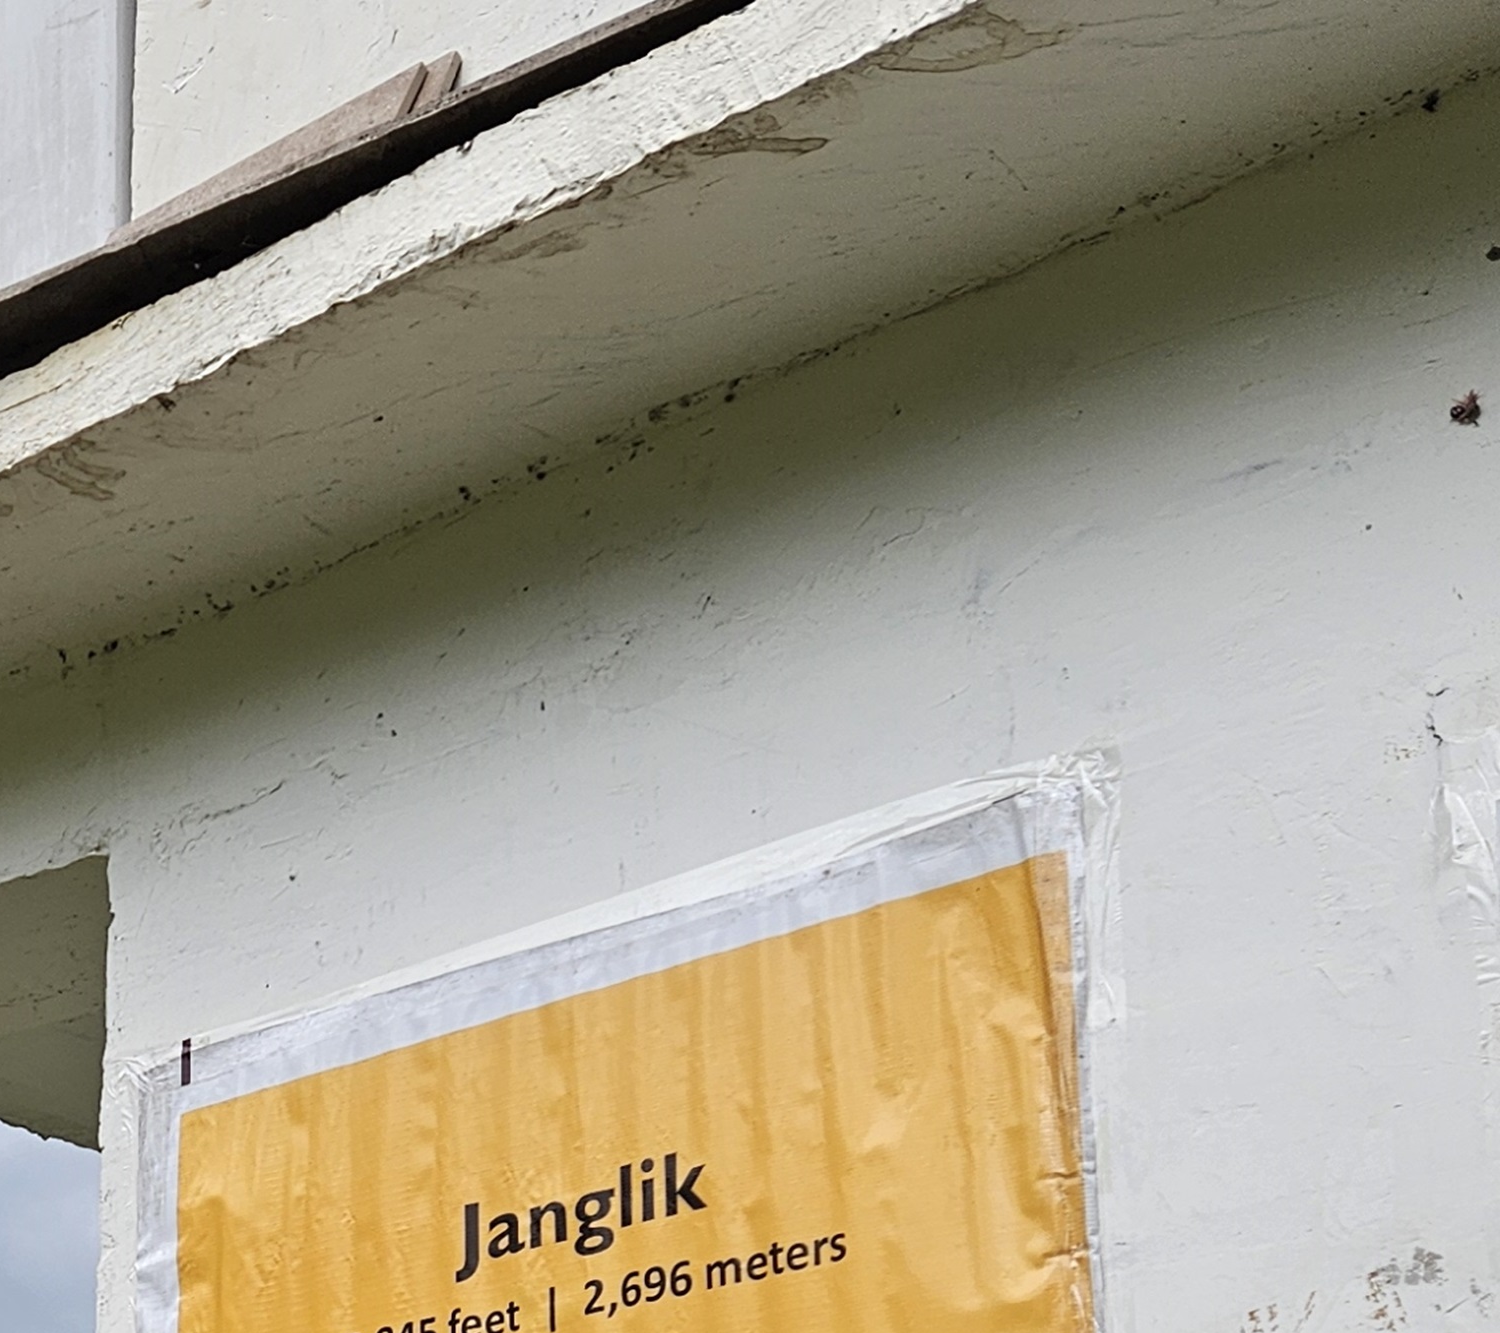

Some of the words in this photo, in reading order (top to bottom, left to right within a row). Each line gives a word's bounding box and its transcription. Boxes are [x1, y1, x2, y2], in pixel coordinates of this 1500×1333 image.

[455, 1152, 707, 1283] Janglik
[584, 1260, 693, 1318] 2,696
[706, 1233, 847, 1290] meters
